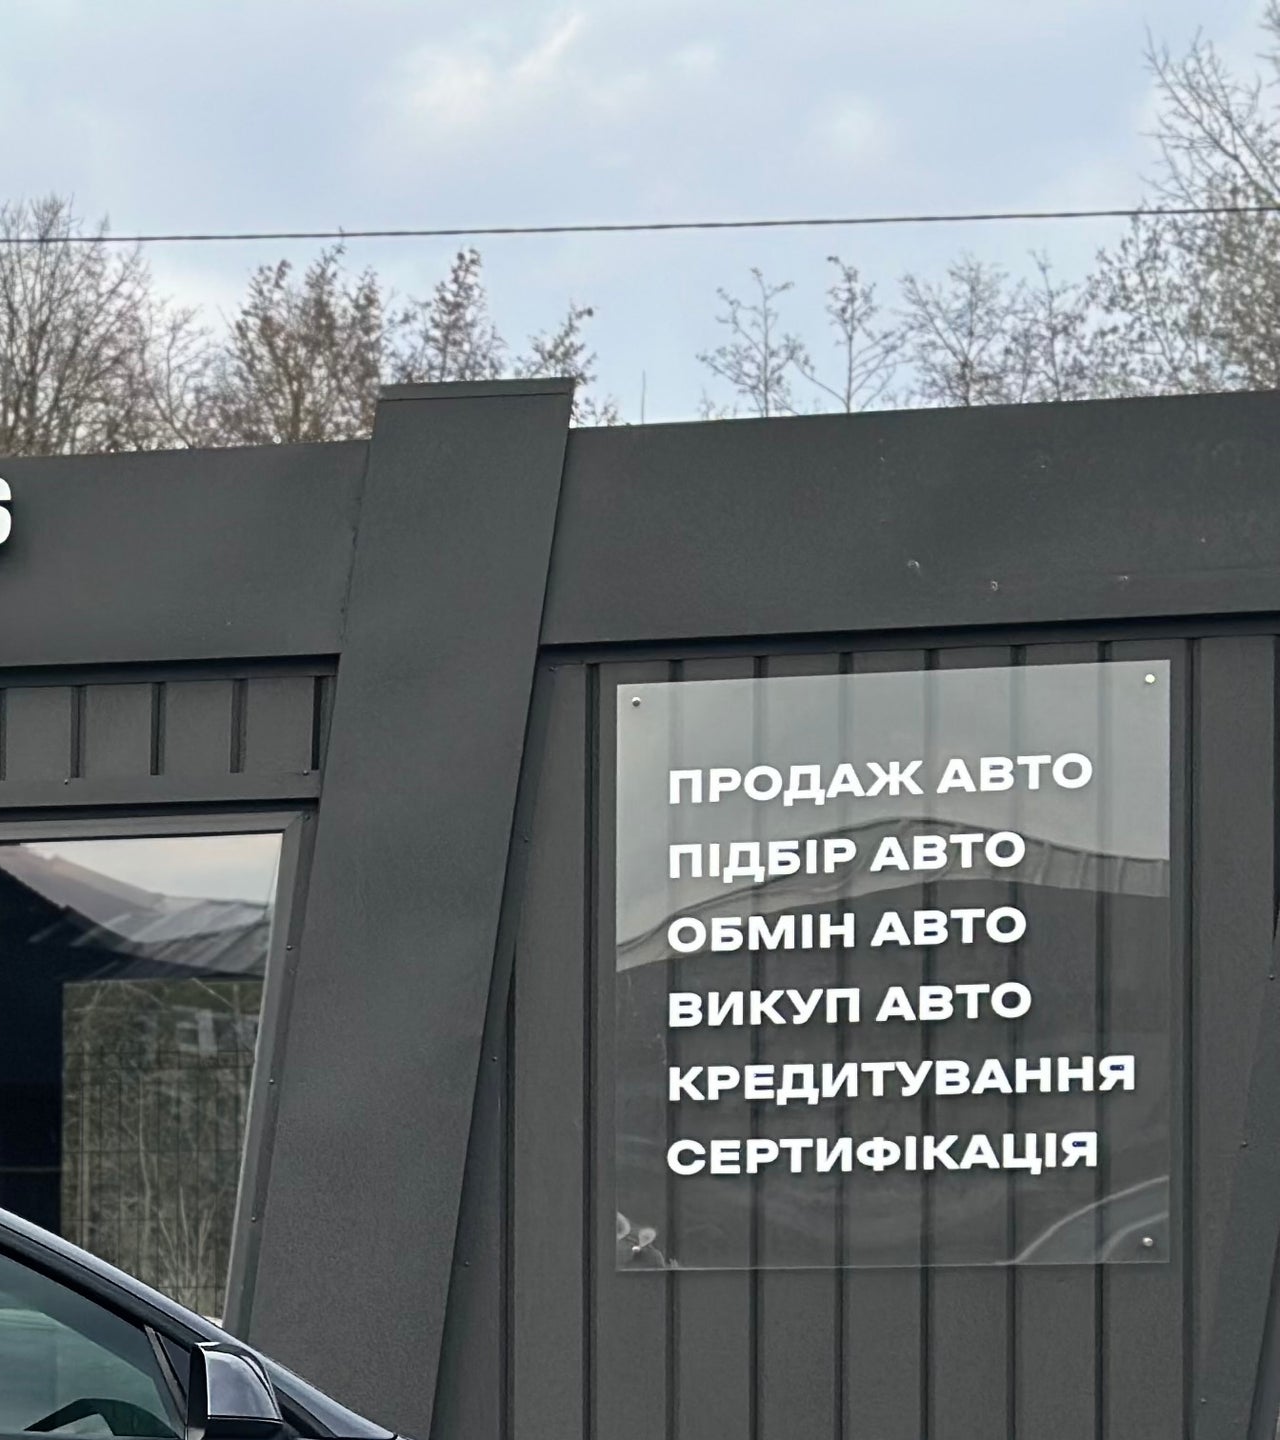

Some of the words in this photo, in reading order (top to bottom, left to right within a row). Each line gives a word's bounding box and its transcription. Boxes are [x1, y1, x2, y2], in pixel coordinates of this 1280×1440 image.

[668, 760, 924, 807] ПРОДАЖ
[936, 752, 1094, 794] АВТО
[668, 837, 857, 884] ПІДБІР
[869, 830, 1027, 873] АВТО
[667, 912, 856, 954] ОБМІН
[870, 906, 1028, 948] АВТО
[668, 987, 860, 1028] ВИКУП
[875, 982, 1032, 1022] АВТО
[668, 1054, 1136, 1106] КРЕДИТУВАННЯ
[667, 1131, 1098, 1175] СЕРТИФІКАЦІЯ
